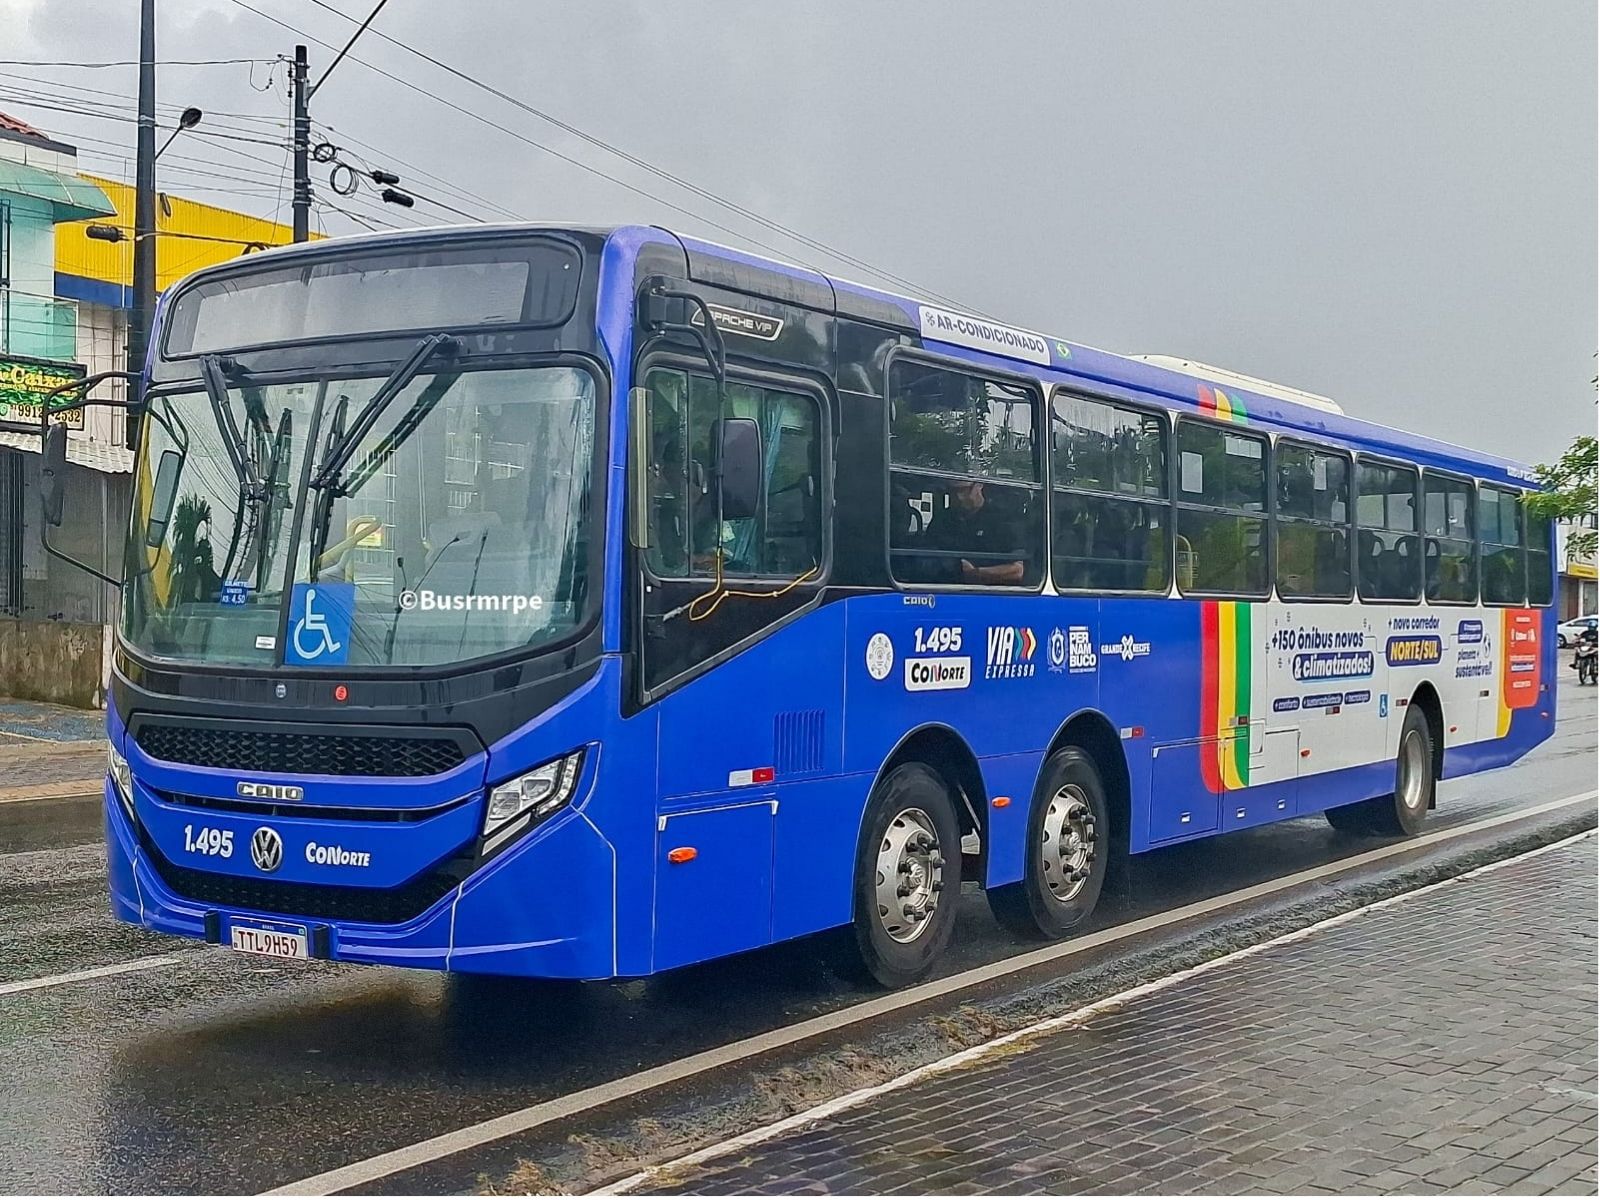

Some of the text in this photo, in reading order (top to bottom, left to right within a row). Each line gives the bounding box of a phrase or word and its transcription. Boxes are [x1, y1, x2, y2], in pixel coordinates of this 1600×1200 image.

[755, 321, 772, 332] VIP
[936, 314, 1045, 354] AR-CONDICIONADO
[231, 594, 246, 604] 4,50
[1393, 617, 1410, 630] novo
[1411, 615, 1440, 630] corredor
[914, 626, 962, 652] 1.495
[1069, 631, 1089, 643] PER
[1297, 626, 1333, 650] ônibus
[1334, 632, 1364, 649] novos
[986, 626, 1015, 665] VIA
[1069, 643, 1092, 655] NAM
[1101, 643, 1150, 654] GRANDE RECIFE
[1390, 640, 1439, 661] NORTE/SUL
[1069, 654, 1097, 667] BUCO
[985, 664, 1035, 679] EXPRESSA
[184, 825, 234, 858] 1.495
[238, 931, 298, 957] TTL9H59
